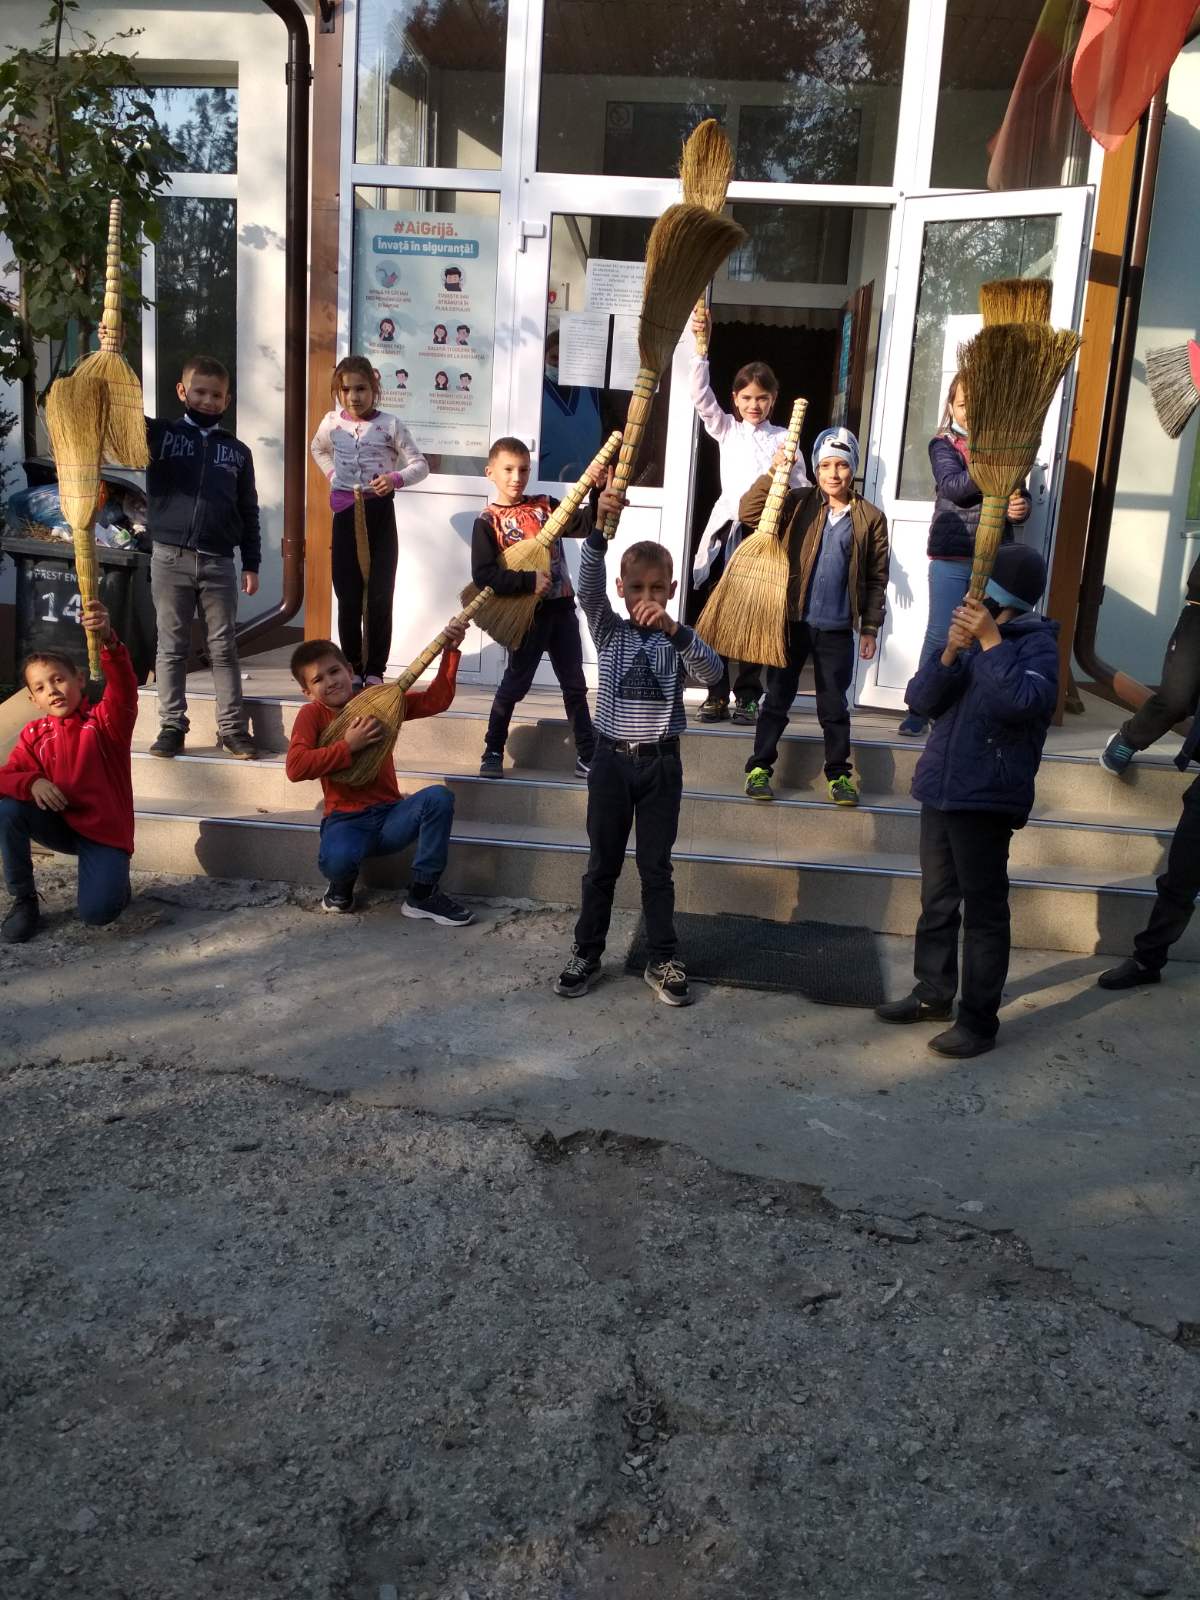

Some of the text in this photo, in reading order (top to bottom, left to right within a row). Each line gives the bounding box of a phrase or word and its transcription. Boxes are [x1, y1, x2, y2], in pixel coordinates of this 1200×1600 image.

[393, 221, 458, 239] #AiGrijă.
[377, 238, 409, 252] Învață
[422, 242, 474, 256] siguranță!
[159, 430, 245, 466] PEPE JEANS
[42, 592, 81, 624] 14
